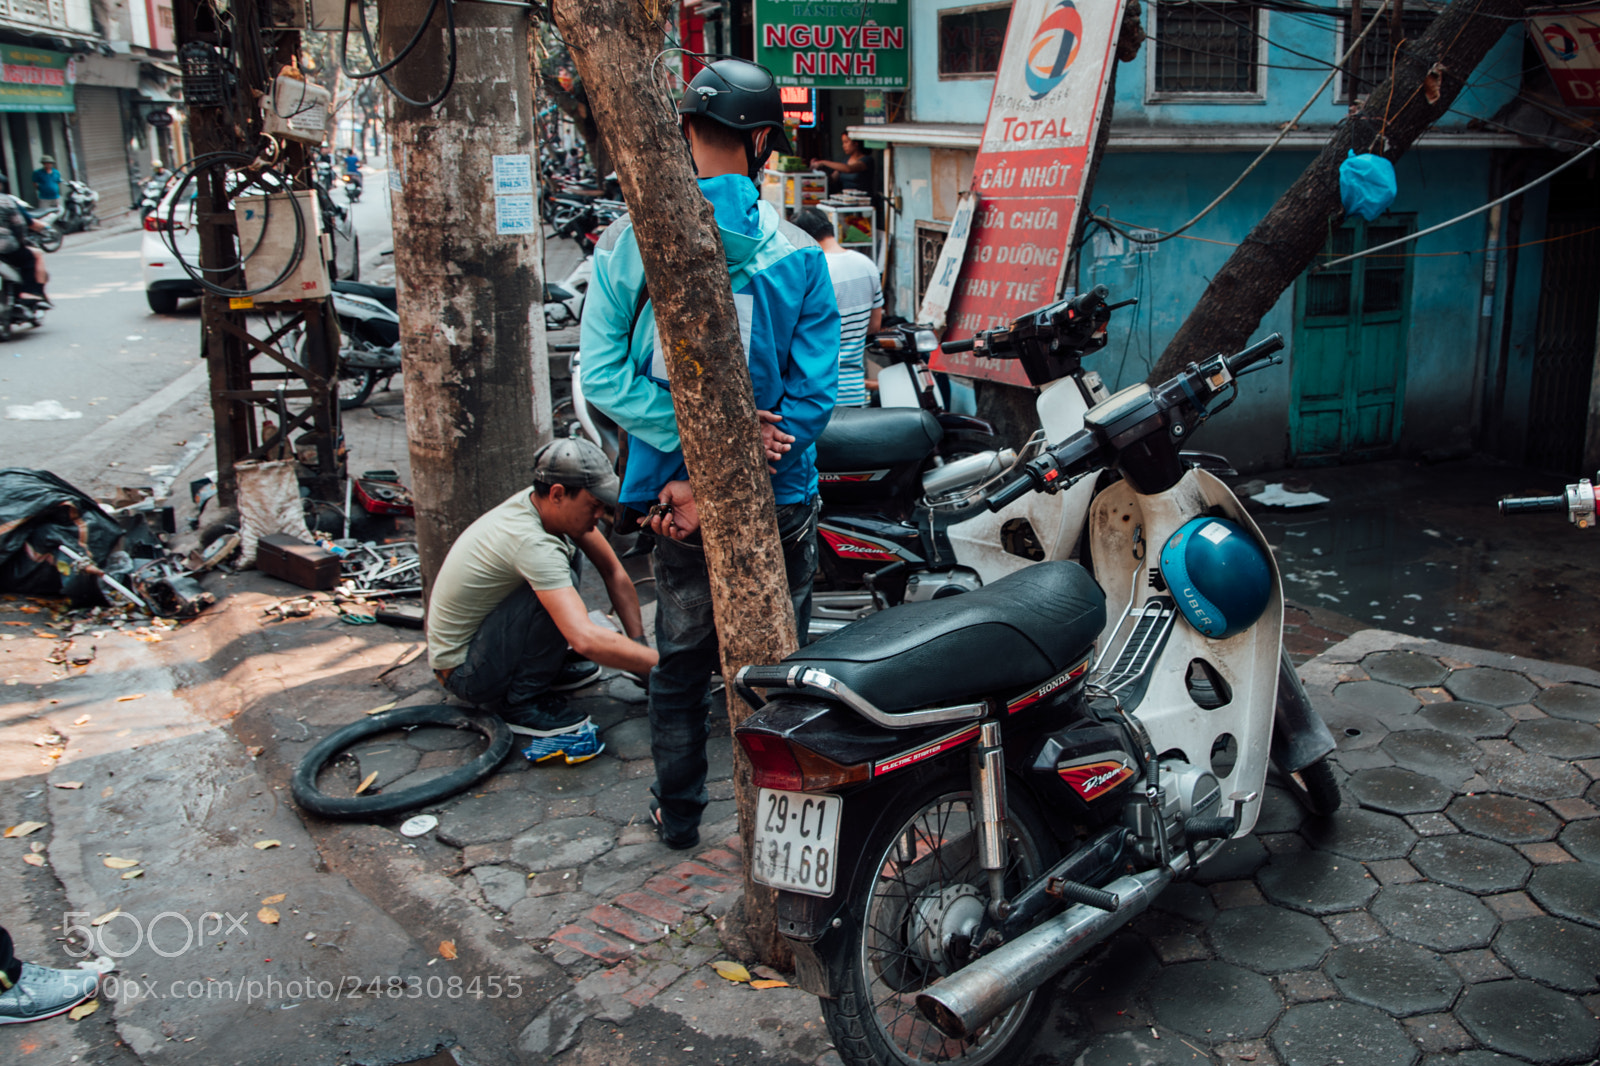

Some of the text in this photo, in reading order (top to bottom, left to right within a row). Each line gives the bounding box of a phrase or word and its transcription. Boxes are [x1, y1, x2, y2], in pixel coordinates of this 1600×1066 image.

[763, 20, 904, 48] NGUYÊN
[793, 51, 876, 75] NINH
[1003, 117, 1072, 142] TOTAL
[980, 159, 1072, 189] DẦU NHỚT
[973, 205, 1004, 229] SỬA
[1009, 206, 1058, 230] CHỮA
[969, 238, 1059, 267] ẢO DƯỠNG
[301, 281, 317, 291] 3M
[958, 276, 1046, 302] THAY THẾ
[836, 543, 885, 553] Dream
[1183, 588, 1212, 625] UBER
[1038, 673, 1071, 697] HONDA
[882, 745, 941, 771] ELECTRIC STARTER
[1081, 766, 1121, 793] Dream
